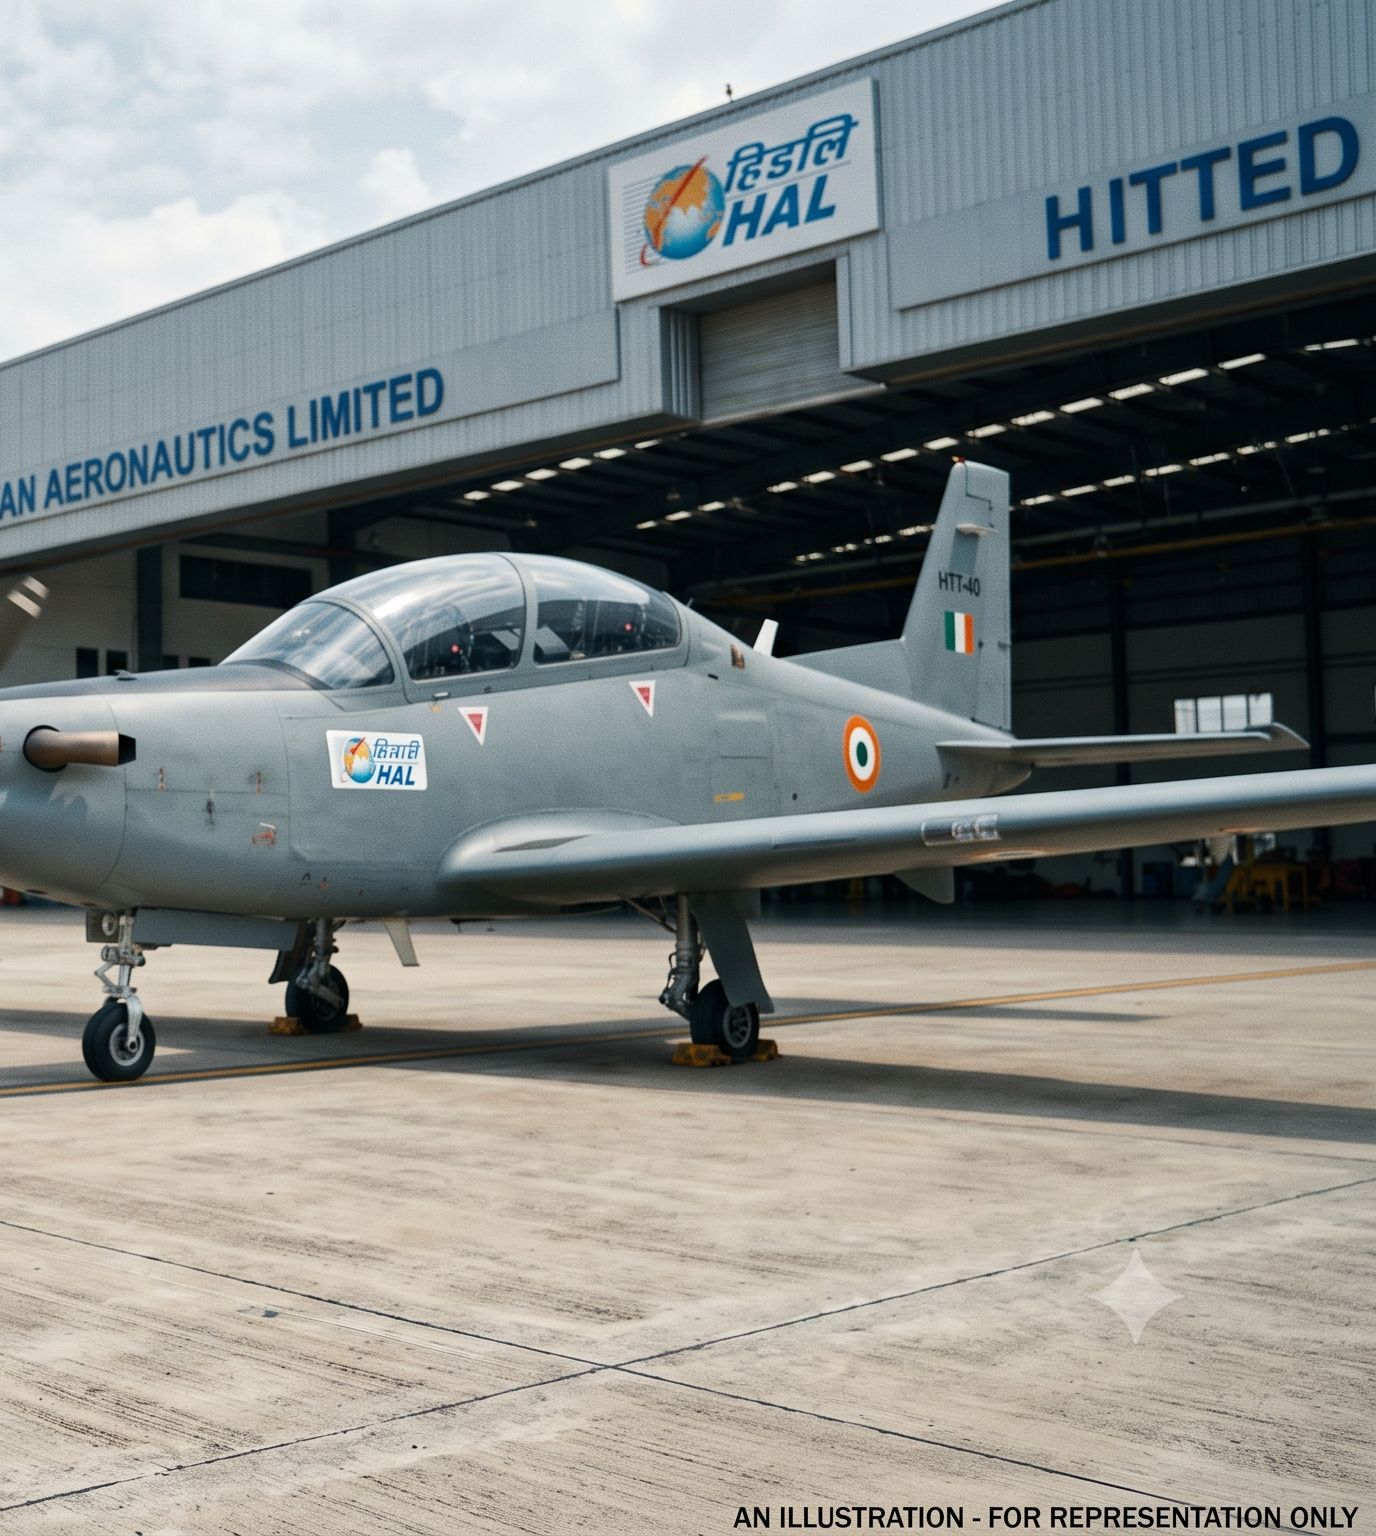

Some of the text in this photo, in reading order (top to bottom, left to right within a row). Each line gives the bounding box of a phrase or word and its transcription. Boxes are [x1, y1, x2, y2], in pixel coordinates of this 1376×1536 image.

[723, 174, 837, 246] HAL
[1044, 115, 1361, 261] HITTED
[43, 411, 274, 509] AERONAUTICS
[286, 367, 444, 449] LIMITED
[938, 570, 981, 598] HTT-40
[376, 764, 415, 786] HAL
